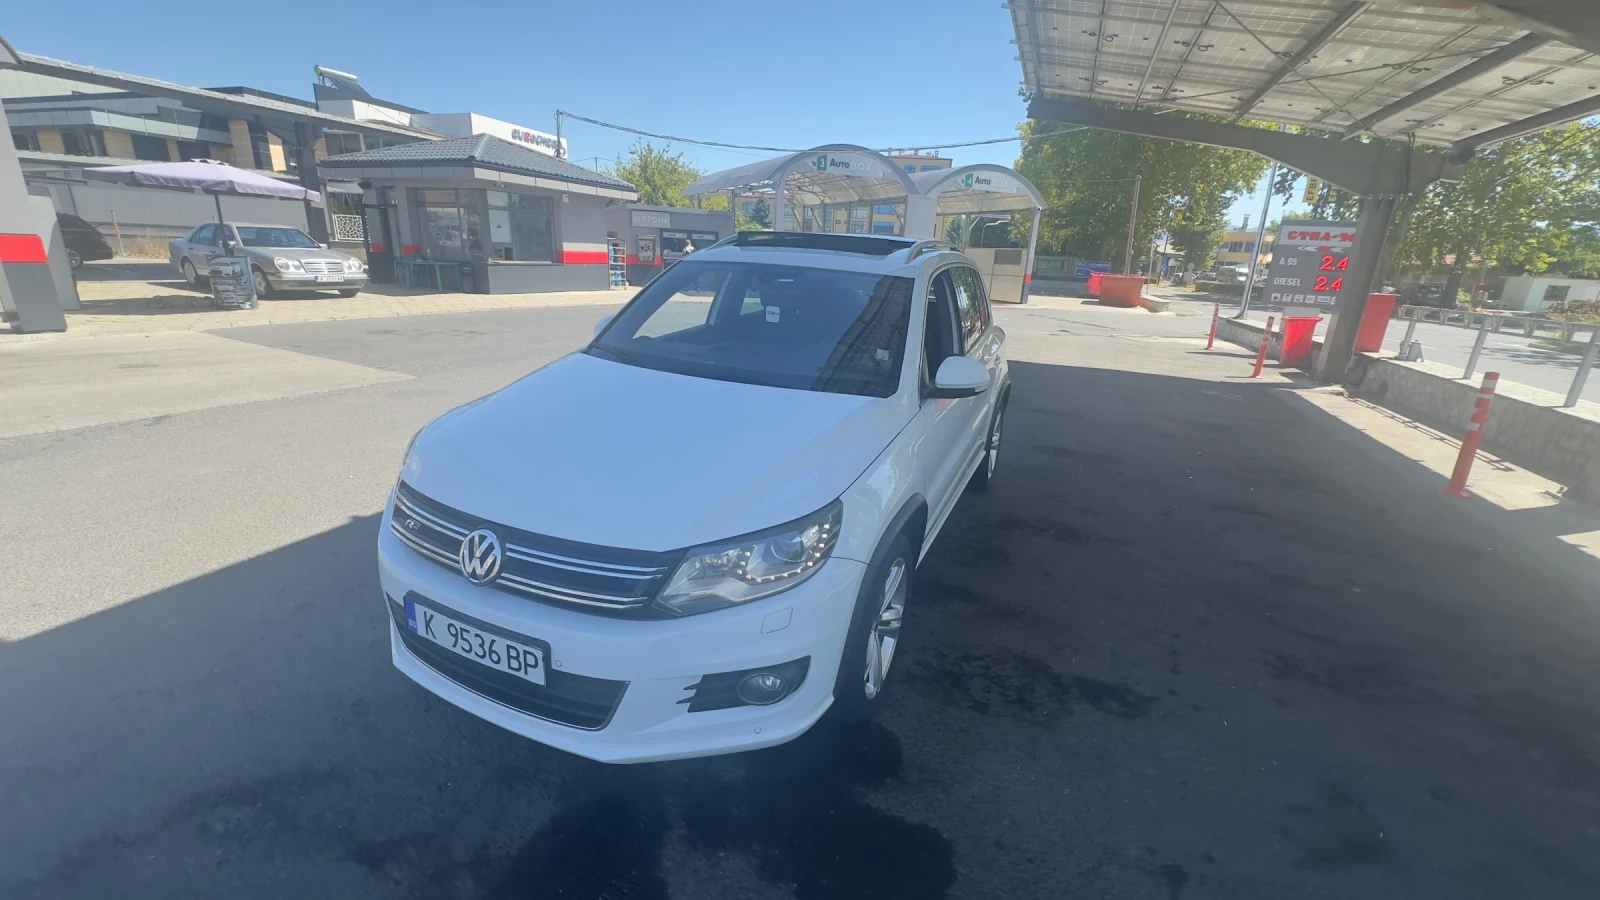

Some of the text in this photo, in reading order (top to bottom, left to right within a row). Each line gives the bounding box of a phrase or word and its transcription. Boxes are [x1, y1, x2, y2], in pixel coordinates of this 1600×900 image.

[1287, 257, 1298, 266] 95
[1273, 277, 1302, 287] DIESEL
[461, 529, 501, 583] VW
[408, 610, 539, 676] BG K 9536 BP
